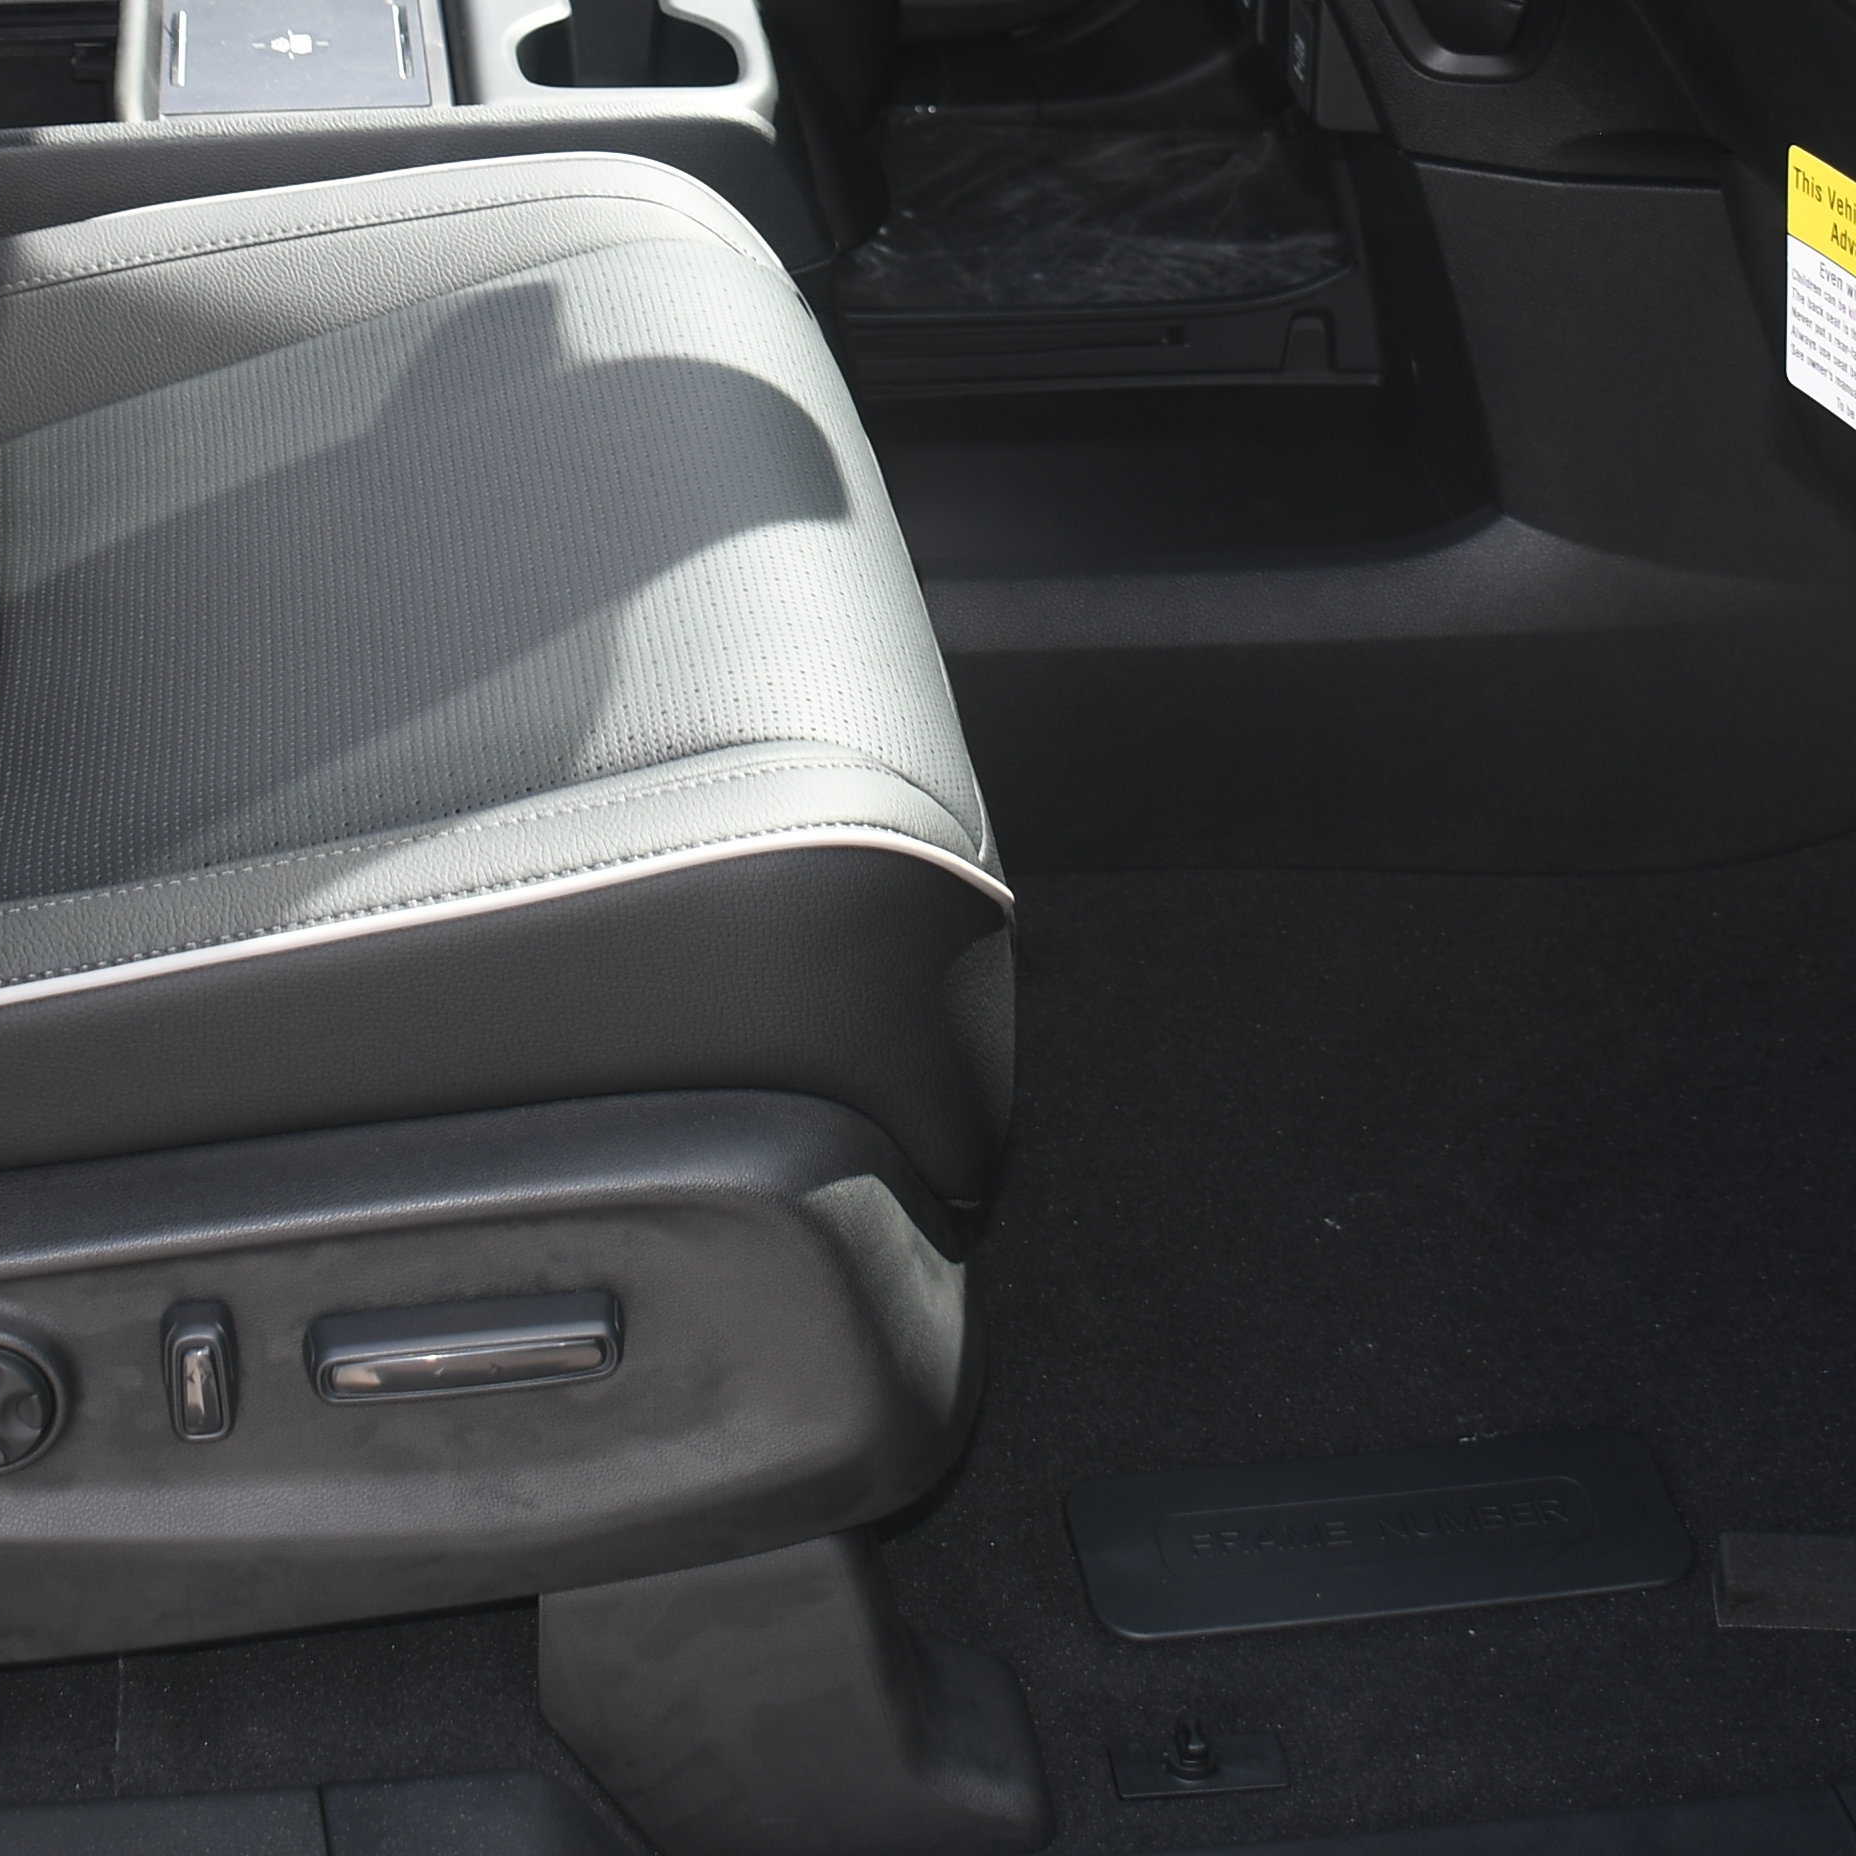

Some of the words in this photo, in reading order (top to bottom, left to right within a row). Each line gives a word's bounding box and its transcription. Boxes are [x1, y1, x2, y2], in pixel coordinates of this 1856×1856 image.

[1793, 166, 1822, 203] This
[1819, 261, 1843, 291] Even
[1190, 1520, 1353, 1559] FRAME
[1377, 1498, 1571, 1541] NUMBER
